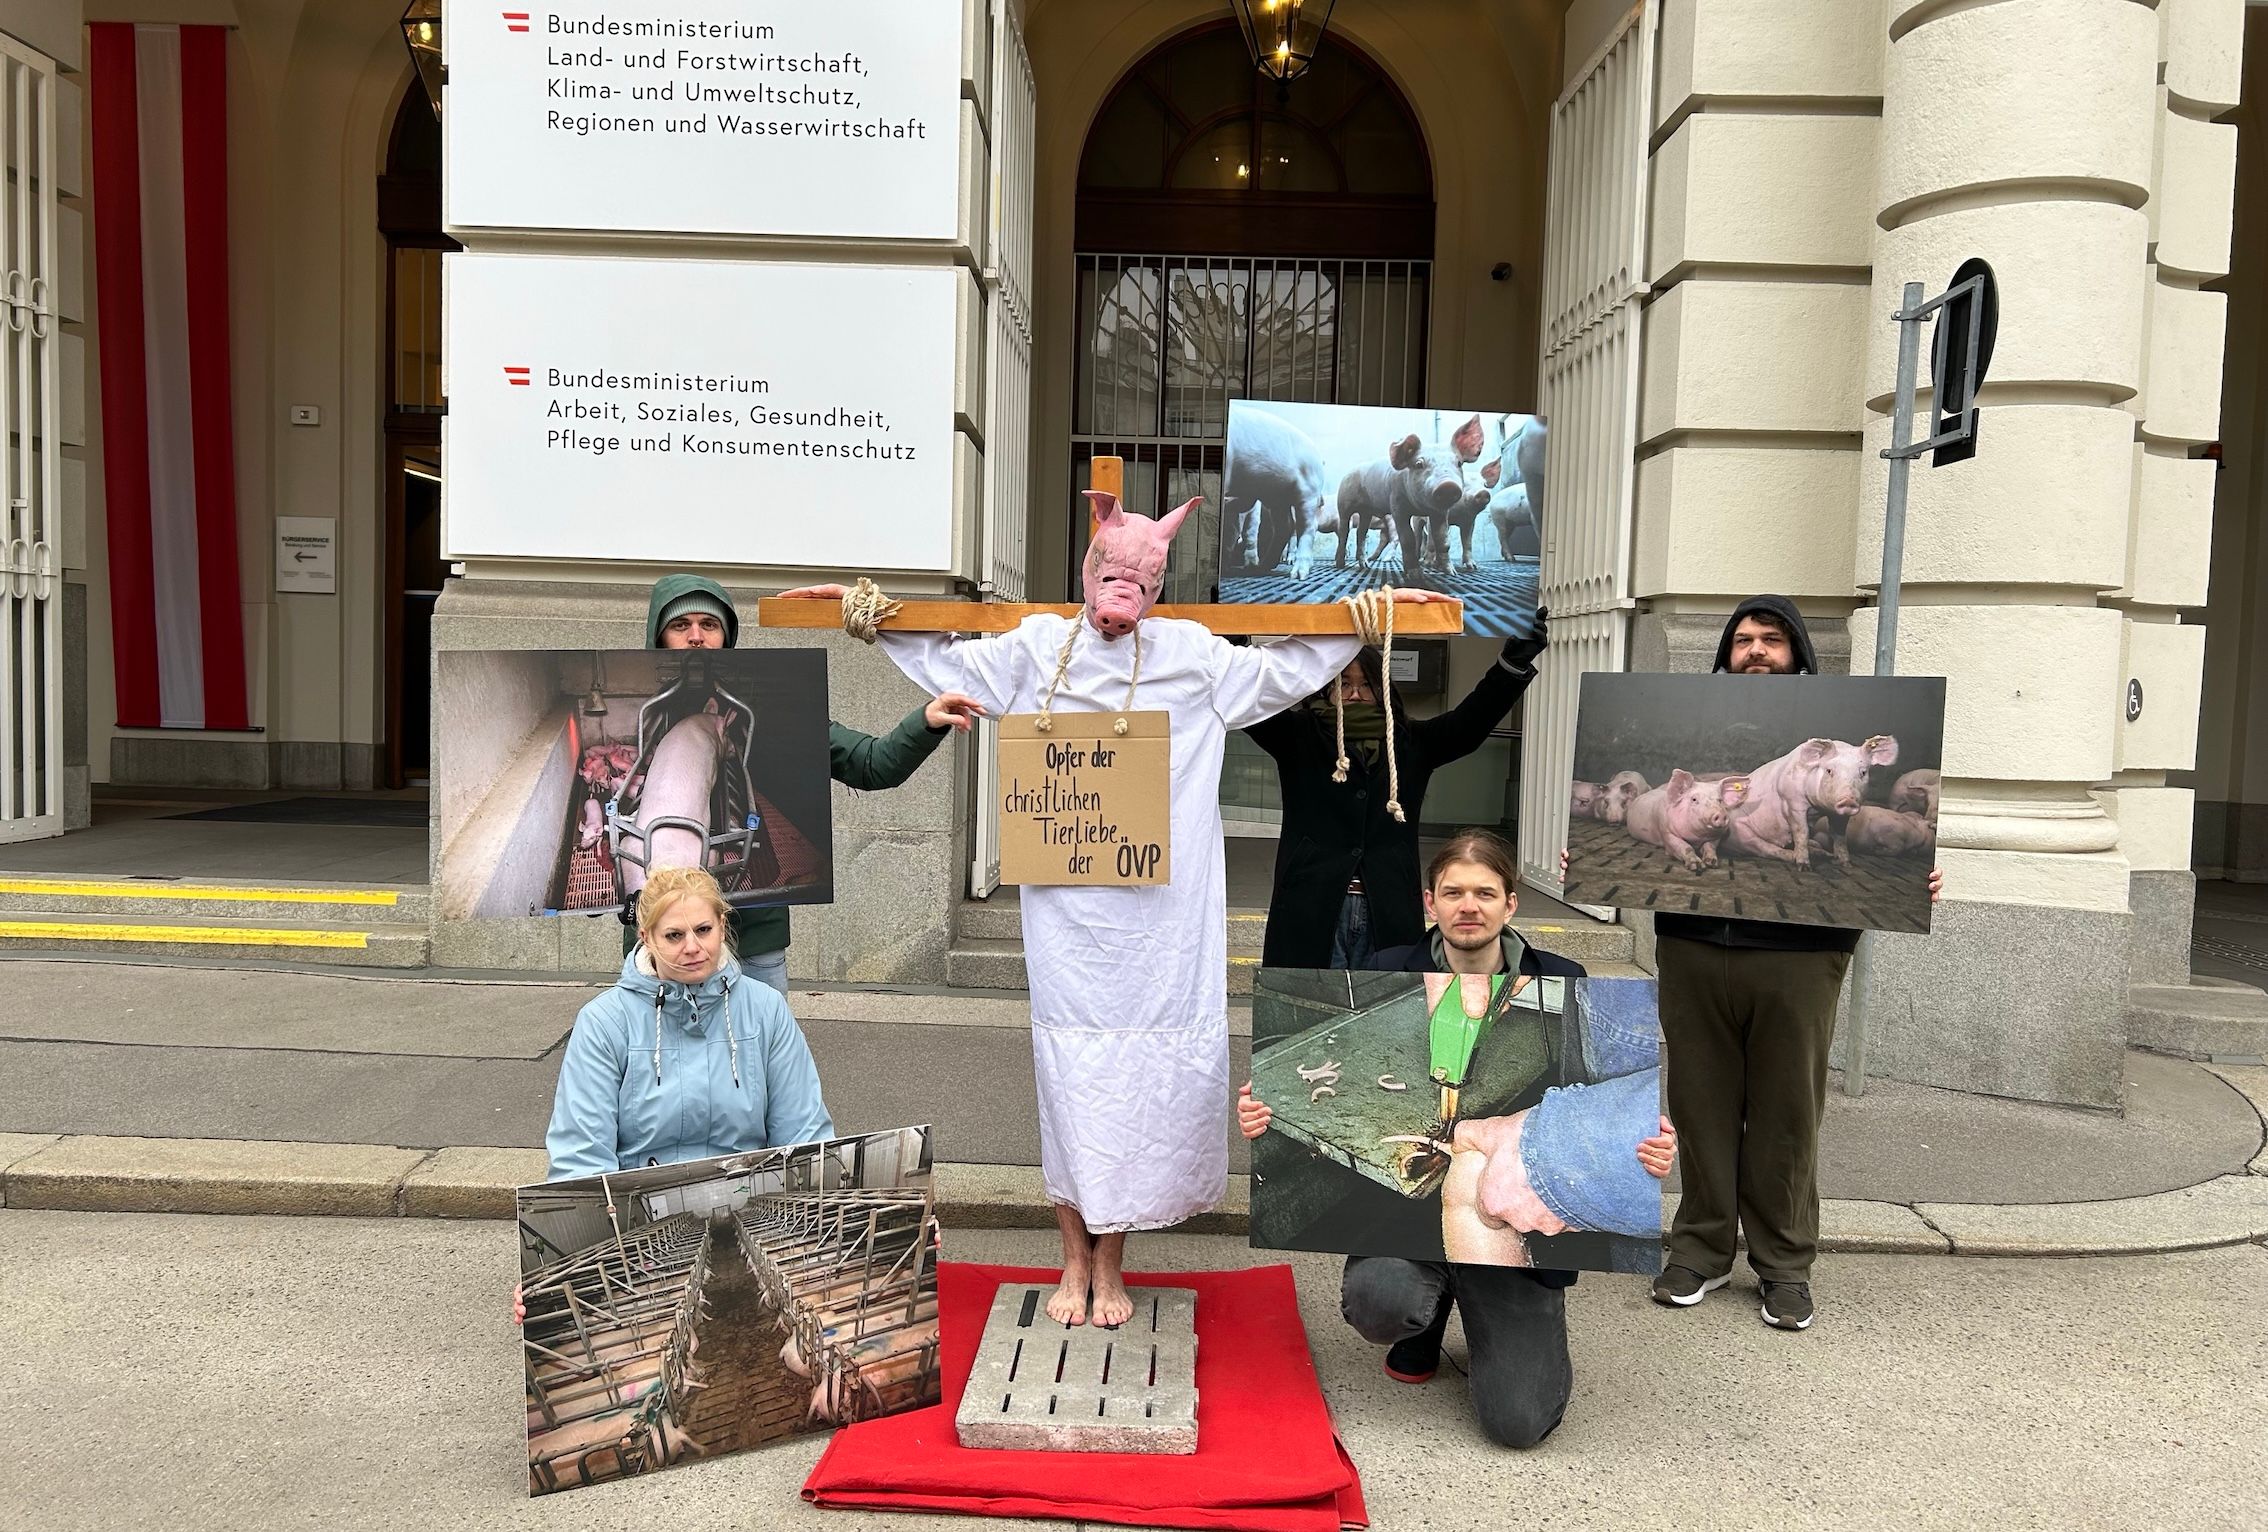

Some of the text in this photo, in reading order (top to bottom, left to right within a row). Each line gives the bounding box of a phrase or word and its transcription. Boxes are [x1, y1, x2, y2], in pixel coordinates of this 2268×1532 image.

[548, 14, 774, 40] Bundesministerium
[548, 46, 868, 78] Land- und Forstwirtschaft,
[548, 77, 861, 110] Klima- und Umweltschutz,
[548, 110, 926, 139] Regionen und Wasserwirtschaft
[548, 368, 769, 394] Bundesministerium
[546, 398, 890, 432] Arbeit, Soziales, Gesundheit,
[548, 428, 916, 460] Pflege und Konsumentenschutz
[1045, 739, 1116, 776] Opfer der
[1005, 775, 1101, 813] christlichen
[1032, 814, 1118, 845] Tierliebe
[1068, 836, 1162, 879] der ÖVP
